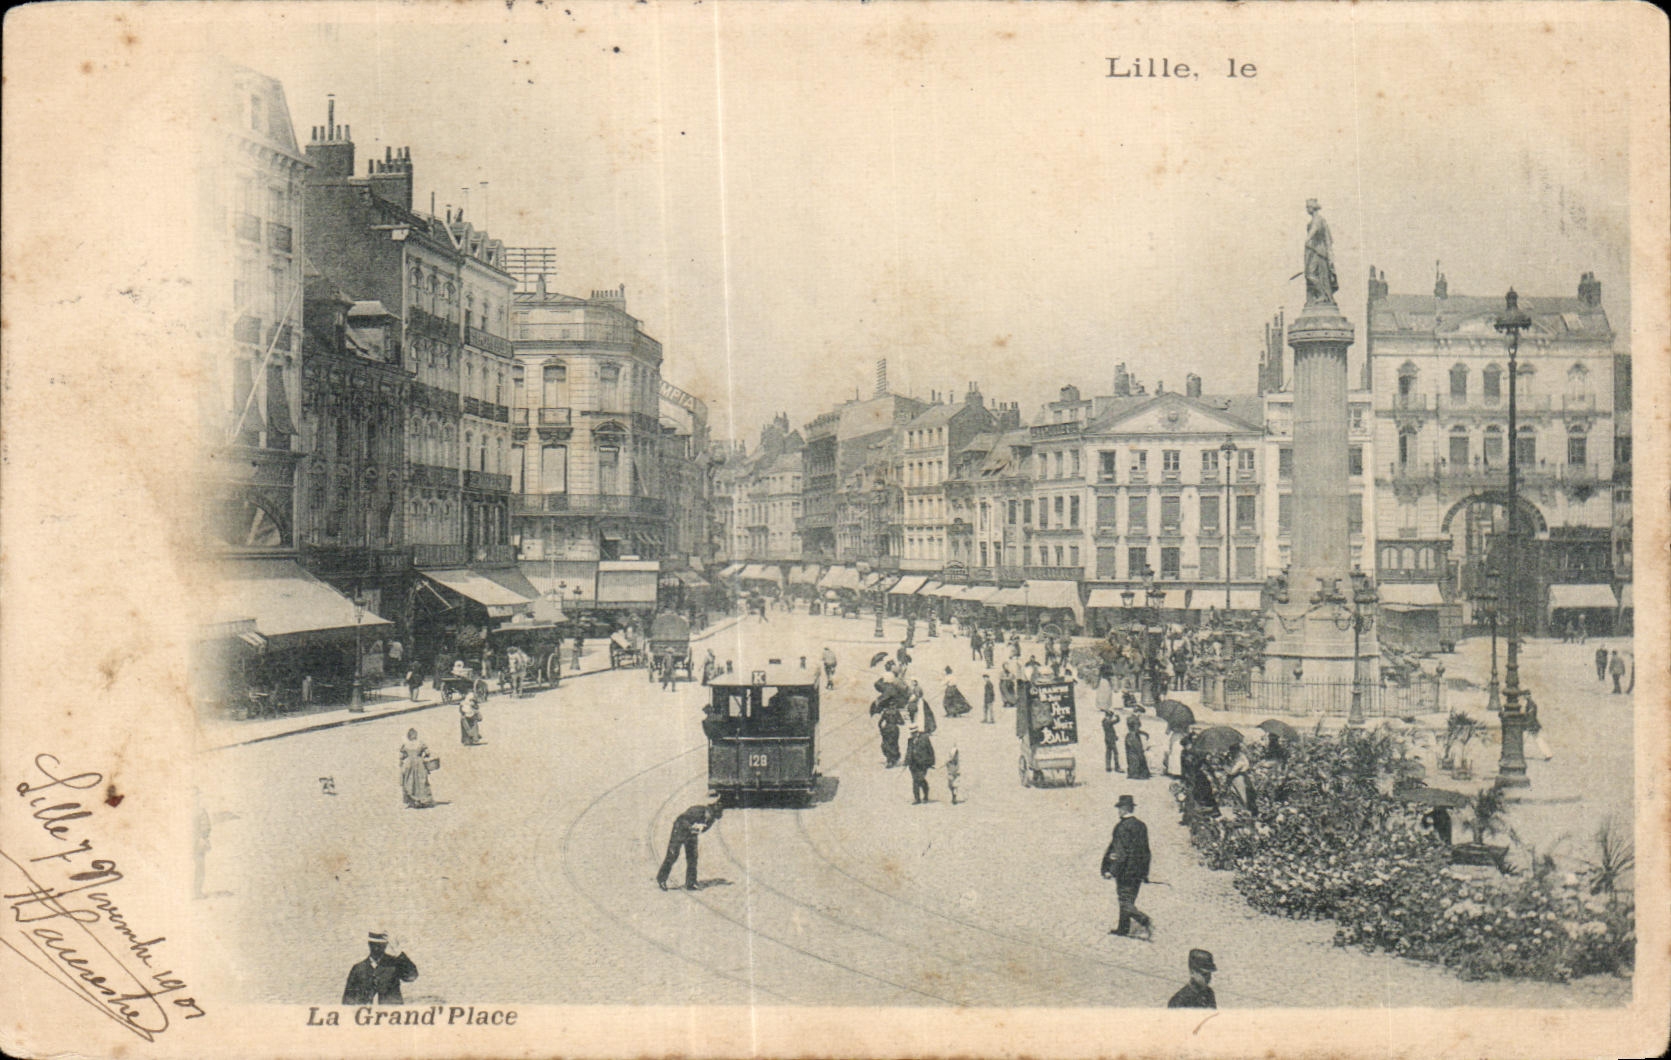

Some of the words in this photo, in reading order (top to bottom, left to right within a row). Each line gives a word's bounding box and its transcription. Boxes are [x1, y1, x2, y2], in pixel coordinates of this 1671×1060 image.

[659, 380, 695, 410] MPIA
[753, 671, 766, 685] K
[748, 754, 768, 767] 128
[16, 753, 103, 841] Lille
